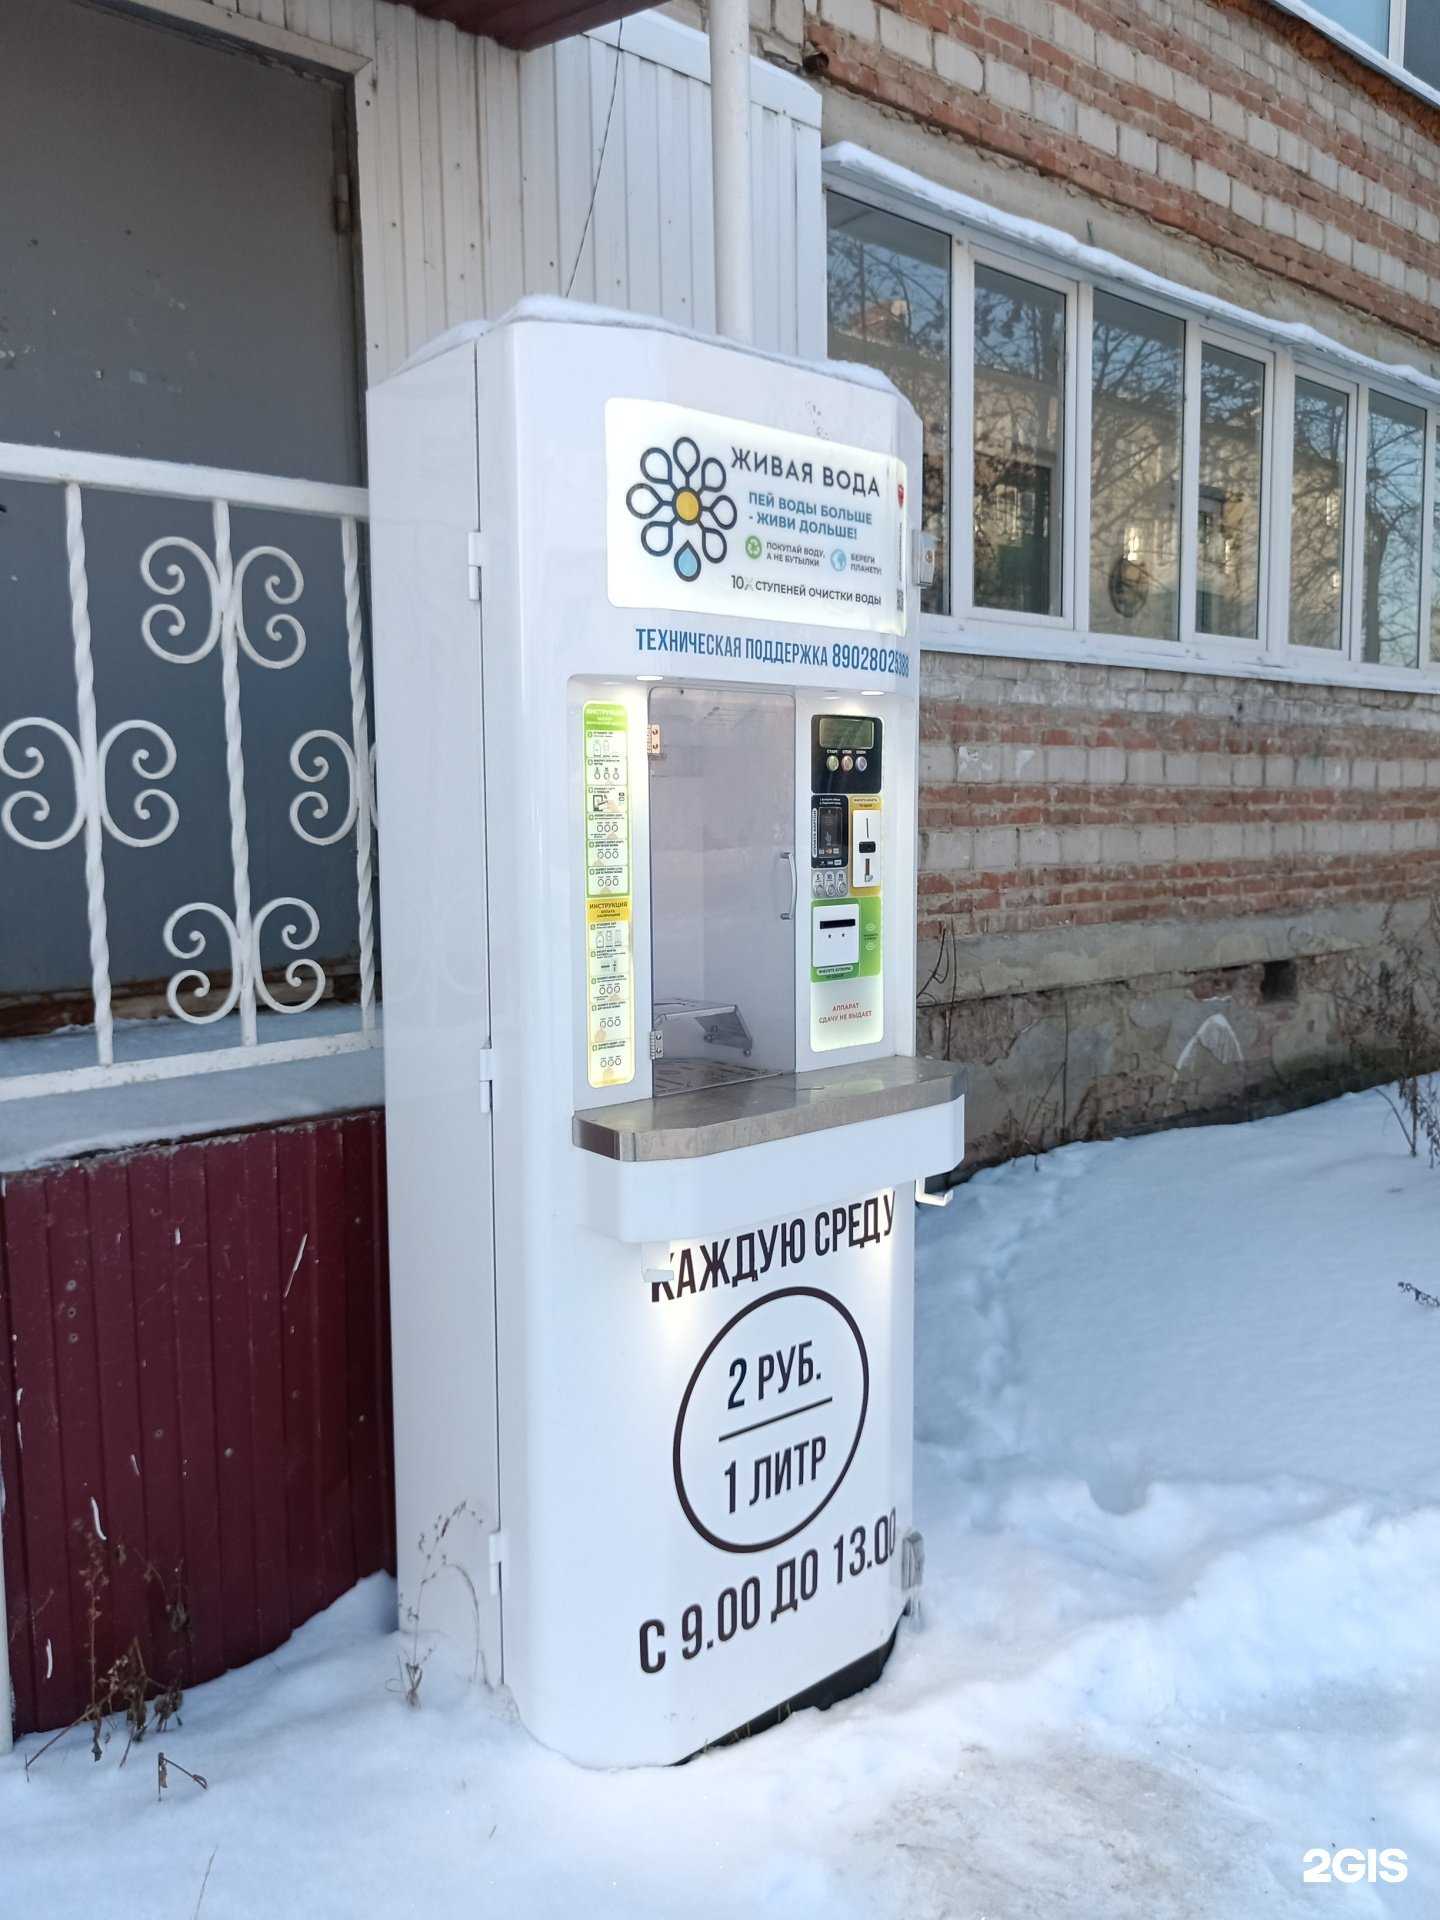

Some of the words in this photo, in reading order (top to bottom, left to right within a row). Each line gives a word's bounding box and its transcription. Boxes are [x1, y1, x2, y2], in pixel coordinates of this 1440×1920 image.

[731, 446, 813, 485] ЖИВАЯ
[823, 466, 881, 498] ВОДА
[749, 491, 775, 509] ПЕЙ
[779, 497, 817, 516] ВОДЫ
[821, 505, 873, 526] БОЛЬШЕ
[757, 511, 796, 531] ЖИВИ
[799, 519, 858, 541] ДОЛЬШЕ!
[766, 541, 803, 555] ПОКУПАЙ
[766, 553, 773, 561] А
[774, 554, 784, 563] НЕ
[785, 555, 820, 567] БУТЫЛКИ
[850, 553, 876, 565] БЕРЕГИ
[755, 580, 807, 597] СТУПЕНЕЙ
[808, 587, 853, 602] ОЧИСТКИ
[855, 593, 882, 606] ВОДЫ
[635, 628, 741, 659] ТЕХНИЧЕСКАЯ
[745, 638, 829, 667] ПОДДЕРЖКА
[589, 901, 628, 909] ИНСТРУКЦИЯ
[818, 1014, 839, 1024] СДАЧУ
[840, 1013, 848, 1021] НЕ
[848, 1010, 873, 1020] ВЫДАЕТ
[832, 1003, 860, 1012] АППАРАТ
[814, 1190, 896, 1257] СРЕДУ
[727, 1357, 748, 1411] 2
[757, 1340, 822, 1401] РУБ.
[723, 1459, 738, 1515] 1
[749, 1435, 827, 1507] ЛИТР
[639, 1618, 667, 1675] С
[681, 1575, 761, 1661] 9.00
[770, 1548, 818, 1624] ДО
[833, 1506, 896, 1585] 13.00
